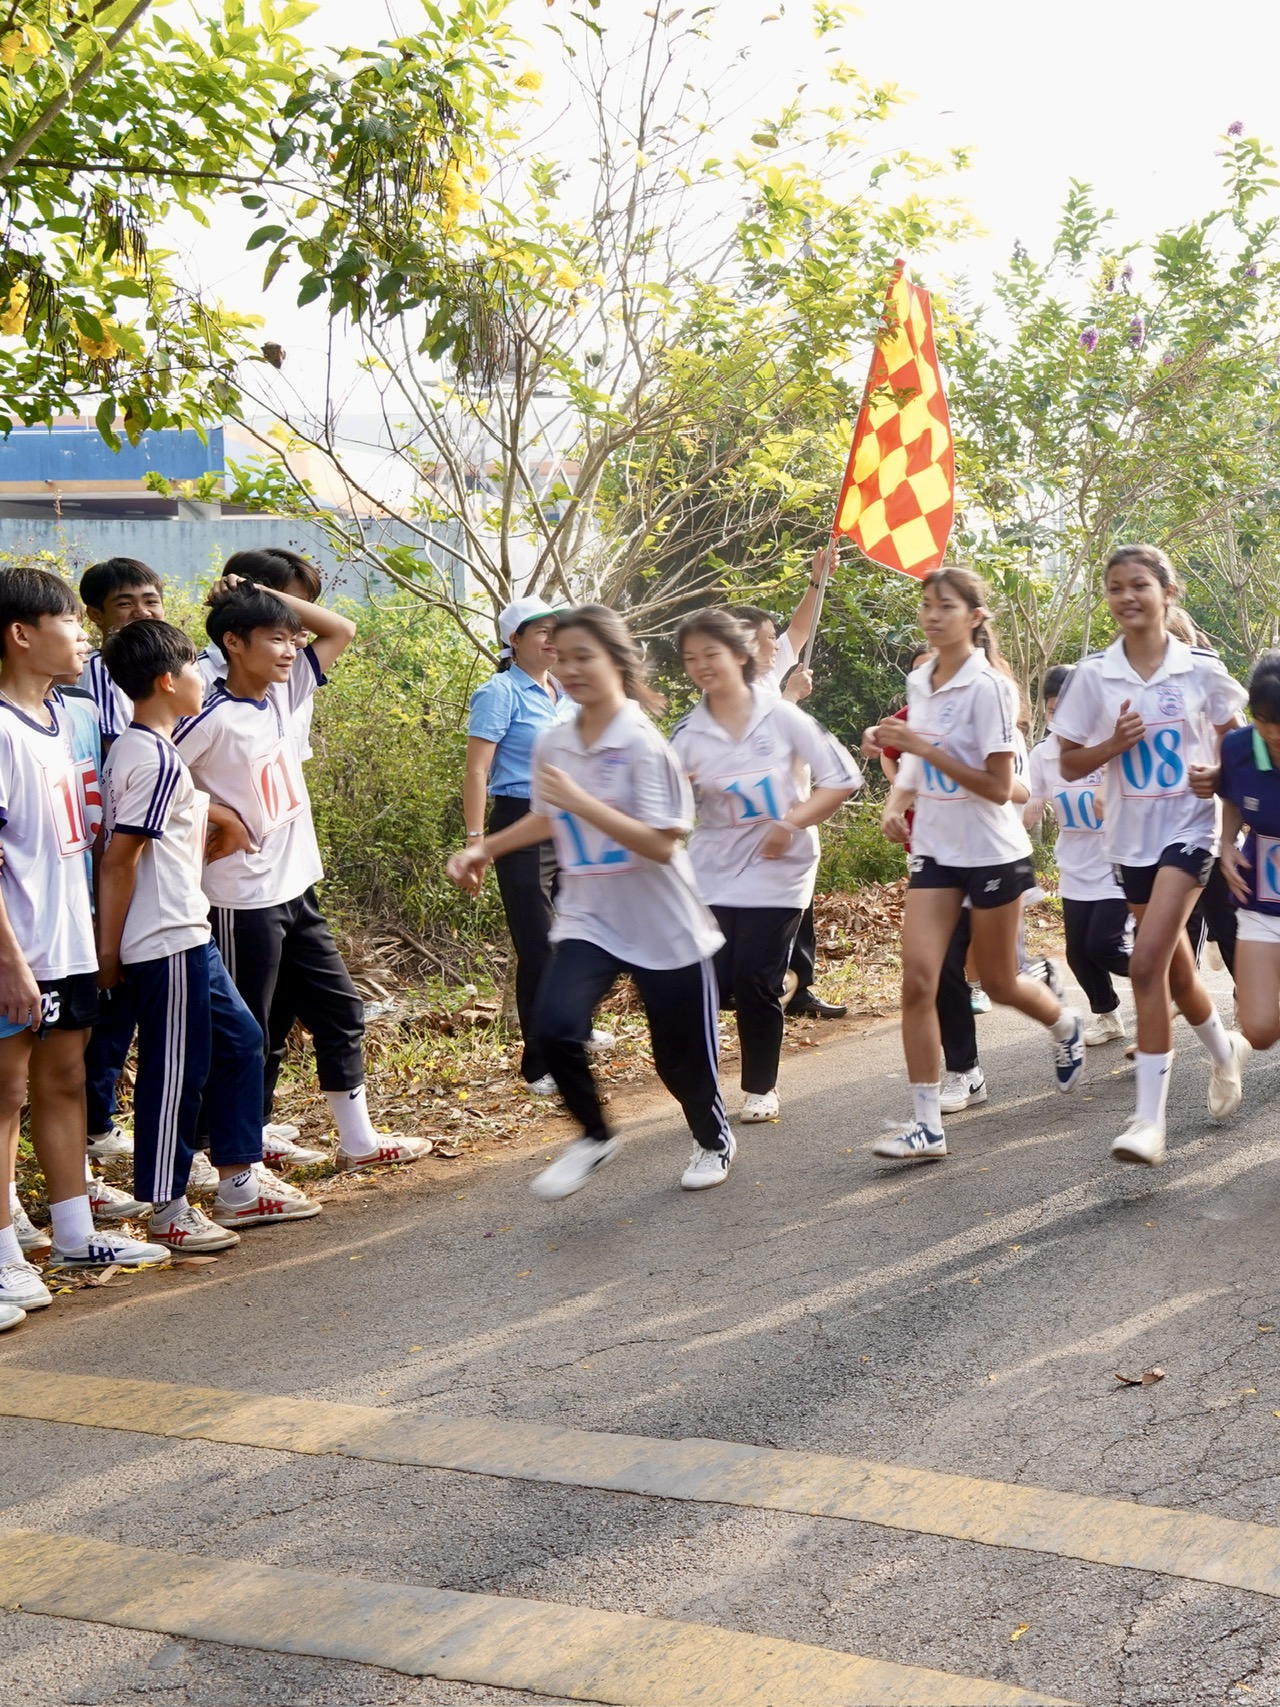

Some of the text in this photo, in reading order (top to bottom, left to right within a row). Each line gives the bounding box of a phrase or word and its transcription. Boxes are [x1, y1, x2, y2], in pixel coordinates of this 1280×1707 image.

[260, 750, 302, 822] 01
[1122, 728, 1185, 791] 08
[723, 774, 782, 821] 11
[1054, 790, 1104, 830] 10
